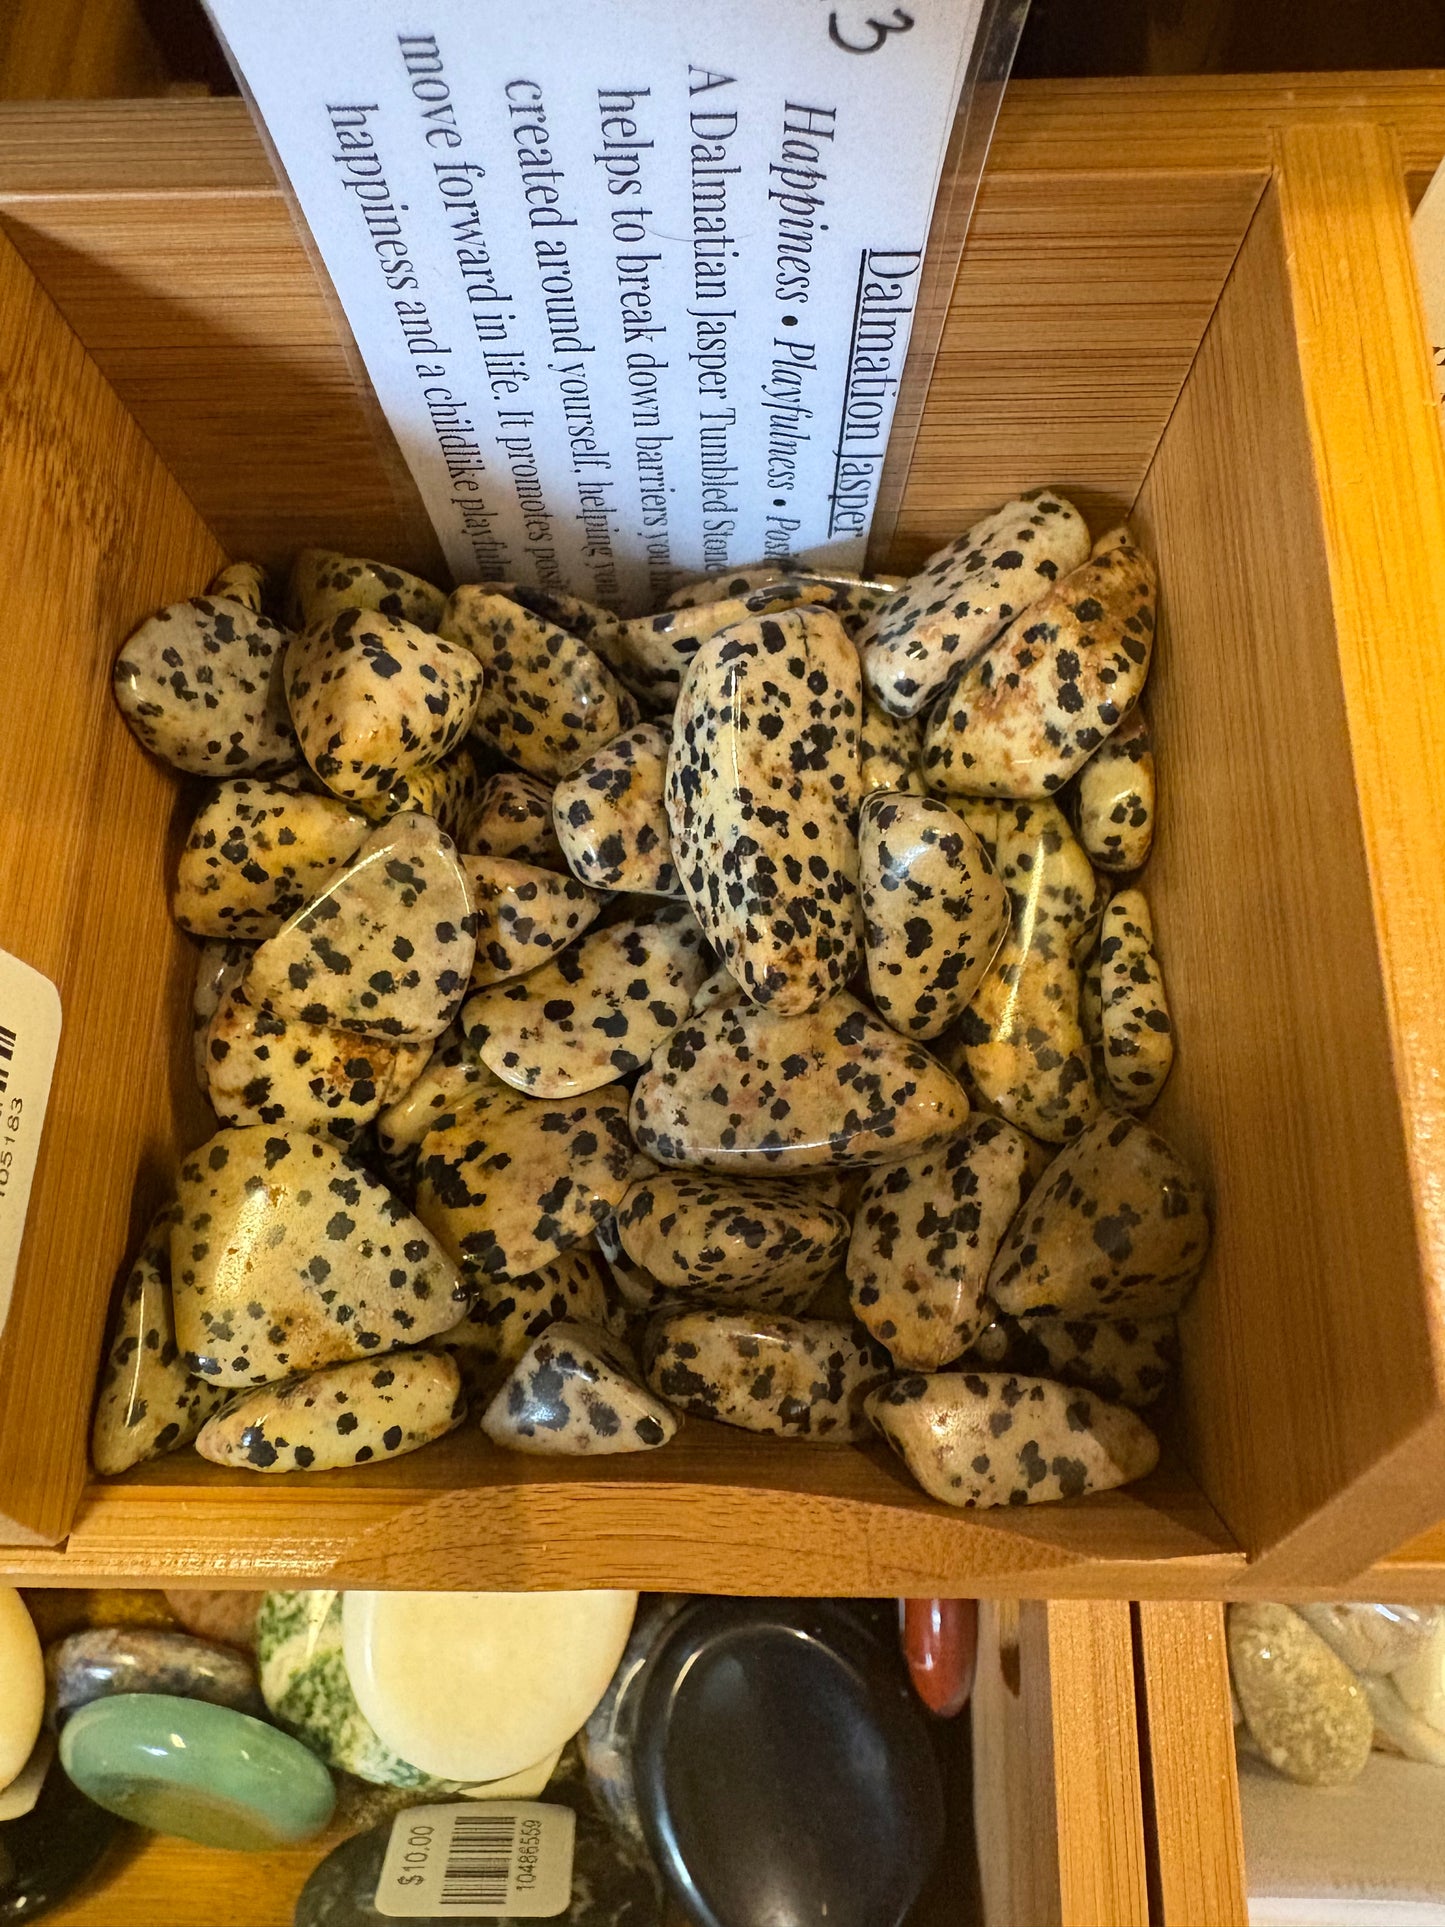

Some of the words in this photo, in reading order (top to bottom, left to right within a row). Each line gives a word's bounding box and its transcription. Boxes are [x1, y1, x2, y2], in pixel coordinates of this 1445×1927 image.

[827, 8, 914, 55] 3
[397, 35, 463, 149] move
[687, 63, 738, 97] A
[504, 79, 579, 229] created
[593, 87, 654, 196] helps
[326, 103, 420, 291] happiness
[433, 161, 513, 304] forward
[611, 207, 653, 243] to
[690, 111, 742, 301] Dalmatian
[768, 99, 837, 304] Happiness
[394, 300, 452, 355] and
[473, 312, 516, 342] in
[534, 240, 596, 354] around
[615, 253, 667, 344] break
[416, 363, 446, 380] a
[483, 350, 530, 401] life.
[626, 352, 669, 428] down
[686, 308, 737, 400] Jasper
[845, 247, 921, 441] Dalmation
[424, 387, 486, 493] childlike
[497, 409, 534, 429] It
[547, 362, 612, 474] yourself,
[699, 407, 739, 513] Tumbled
[760, 337, 818, 491] Playfulness
[496, 436, 554, 542] promotes
[576, 481, 620, 558] helping
[634, 435, 676, 527] barriers
[827, 449, 884, 537] Jasper
[637, 531, 671, 565] you
[397, 1825, 435, 1886] $10.00
[516, 1820, 542, 1891] 10486559
